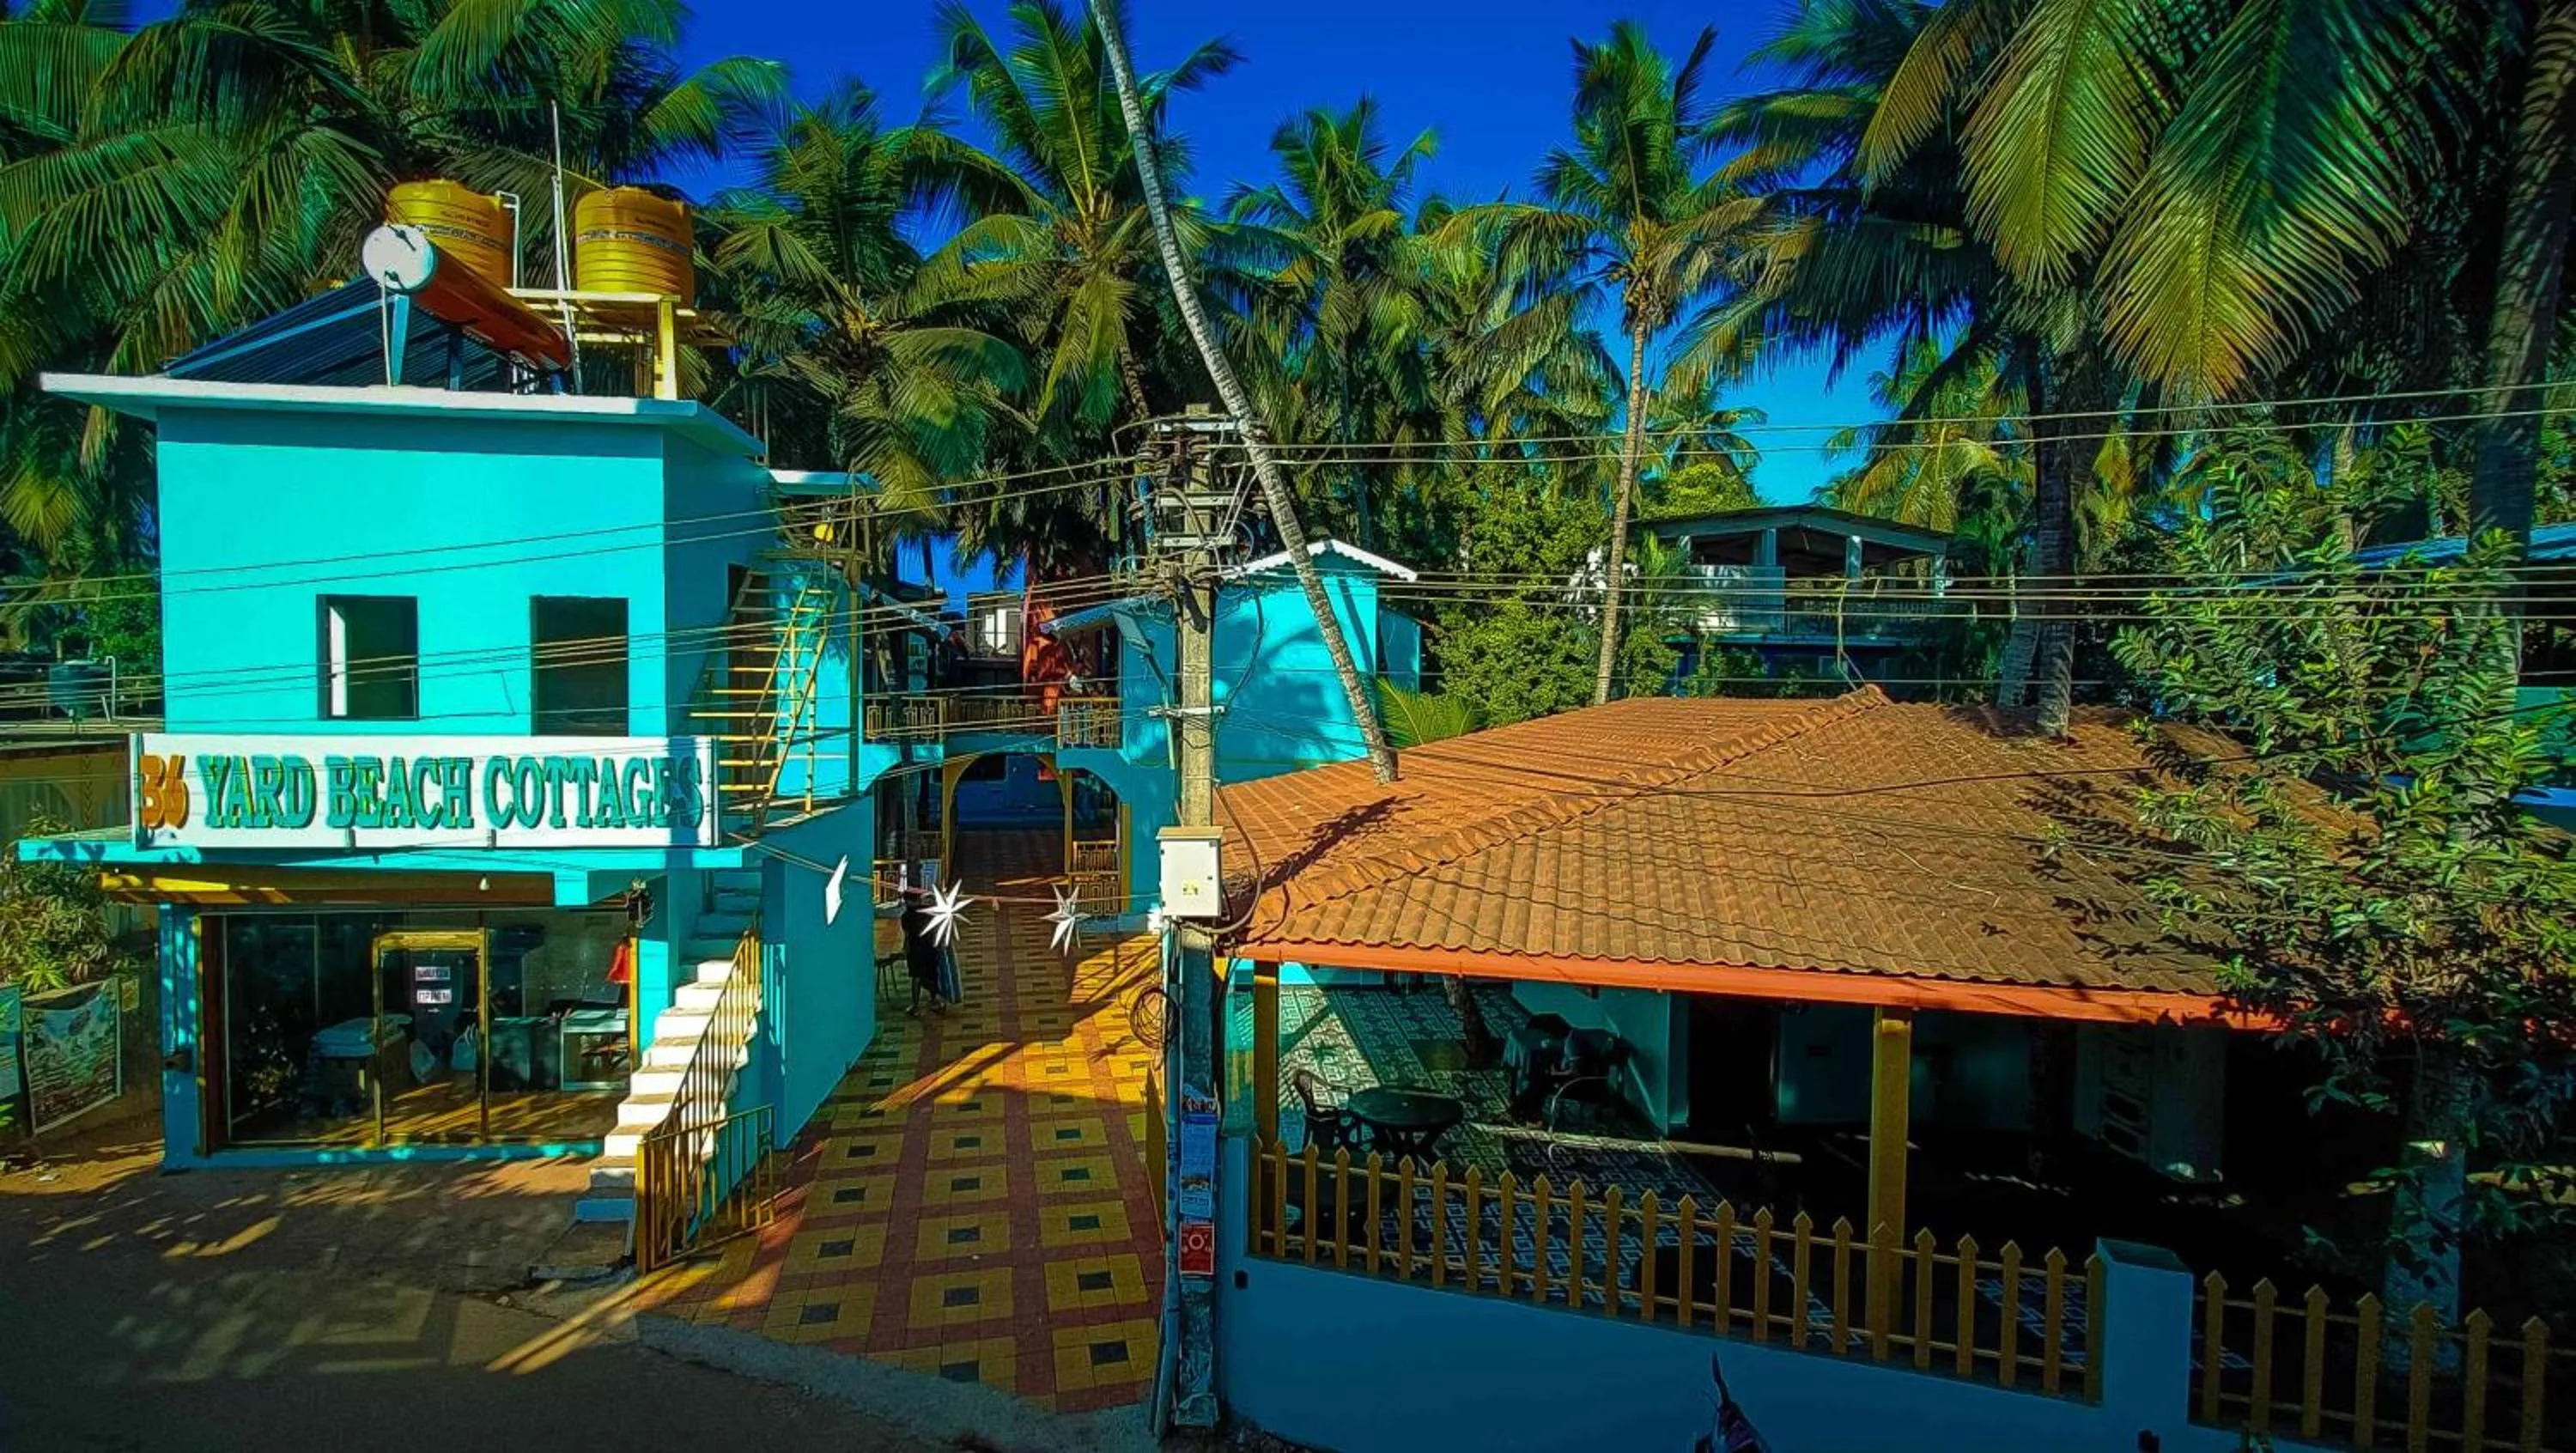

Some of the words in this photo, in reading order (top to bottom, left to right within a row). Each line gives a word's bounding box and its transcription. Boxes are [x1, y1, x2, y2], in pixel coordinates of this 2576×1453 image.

[140, 755, 189, 830] 36
[196, 755, 317, 829] YARD
[325, 756, 475, 830] BEACH
[483, 756, 704, 830] COTTAGES
